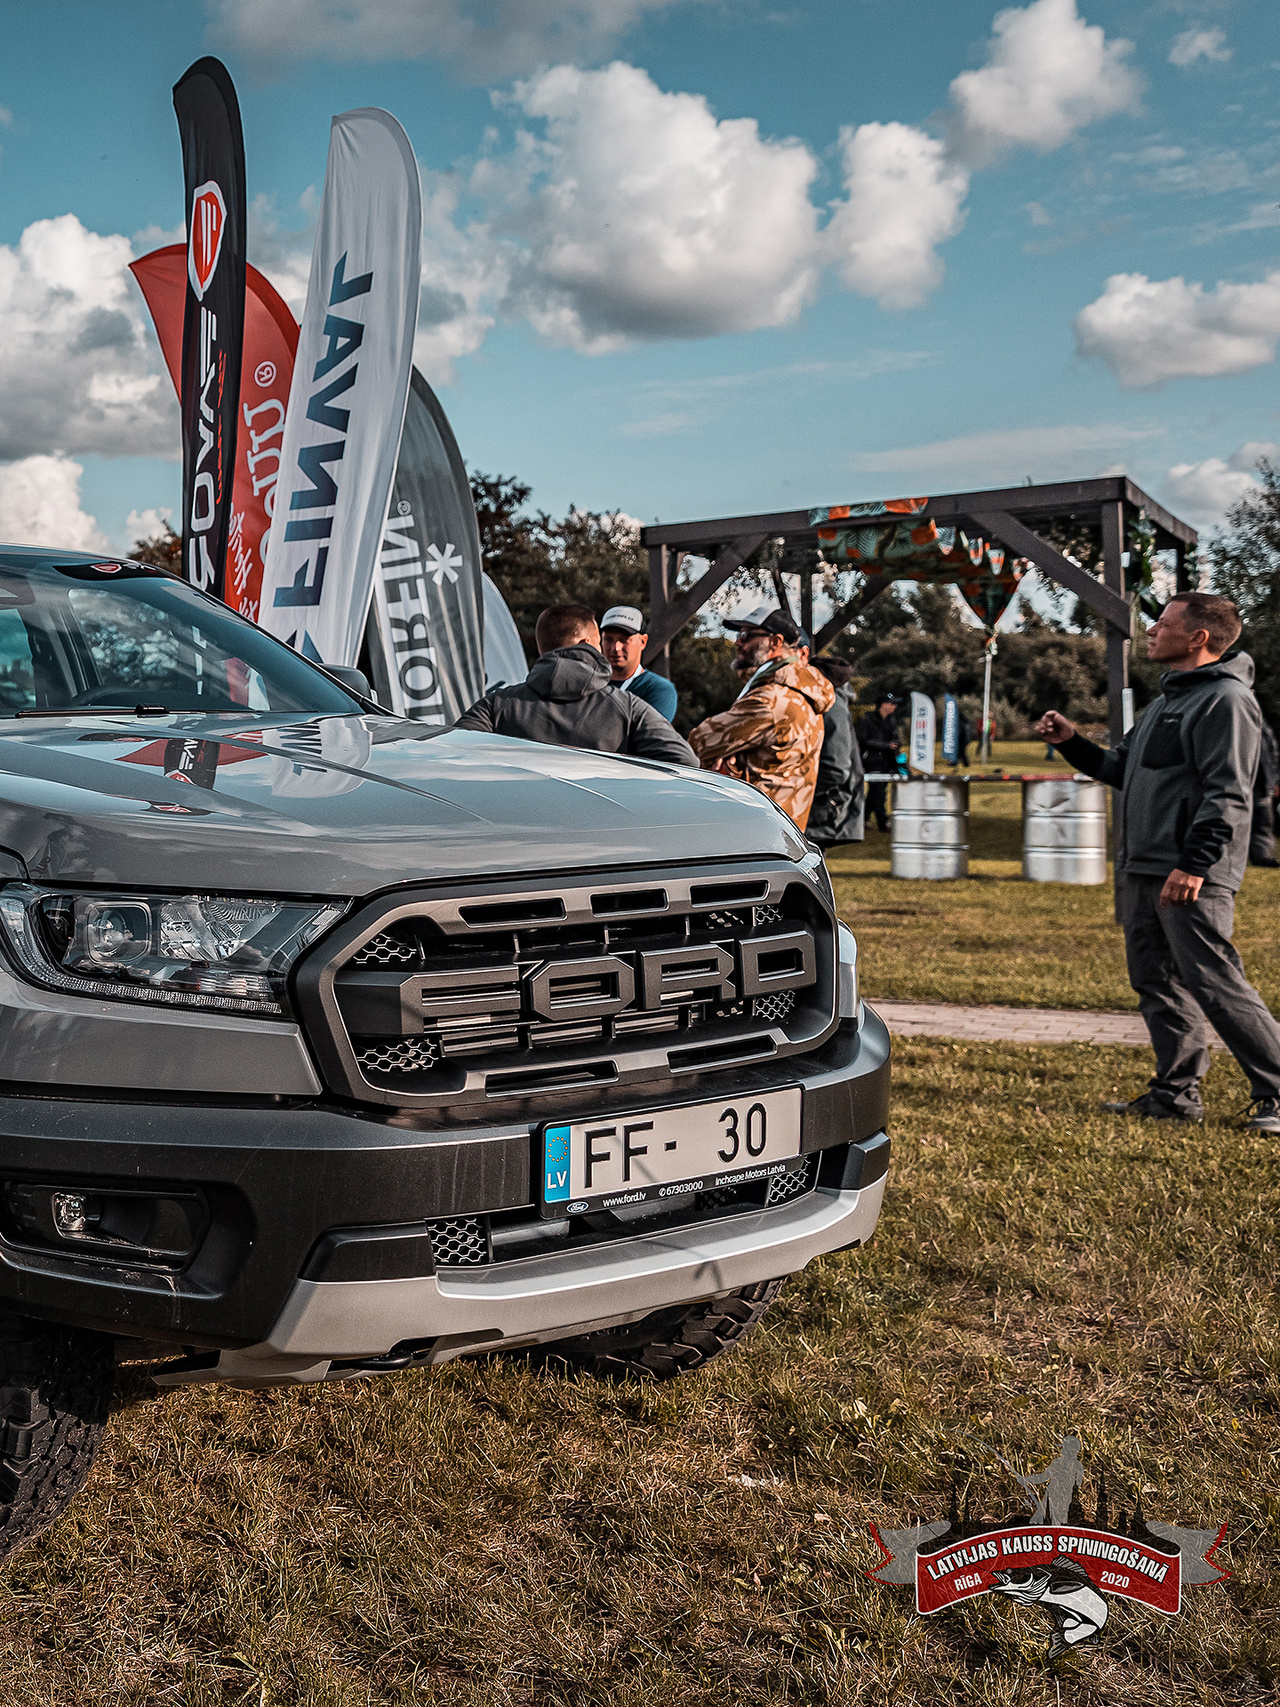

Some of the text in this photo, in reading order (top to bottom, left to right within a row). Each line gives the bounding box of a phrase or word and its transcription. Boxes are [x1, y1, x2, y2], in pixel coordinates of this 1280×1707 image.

[400, 930, 817, 1036] FORD
[718, 1102, 768, 1164] 30
[547, 1169, 567, 1191] LV
[602, 1191, 647, 1208] www.ford.lv
[714, 1173, 745, 1186] Inchcape
[744, 1169, 767, 1180] Motors
[767, 1163, 786, 1175] Latvia
